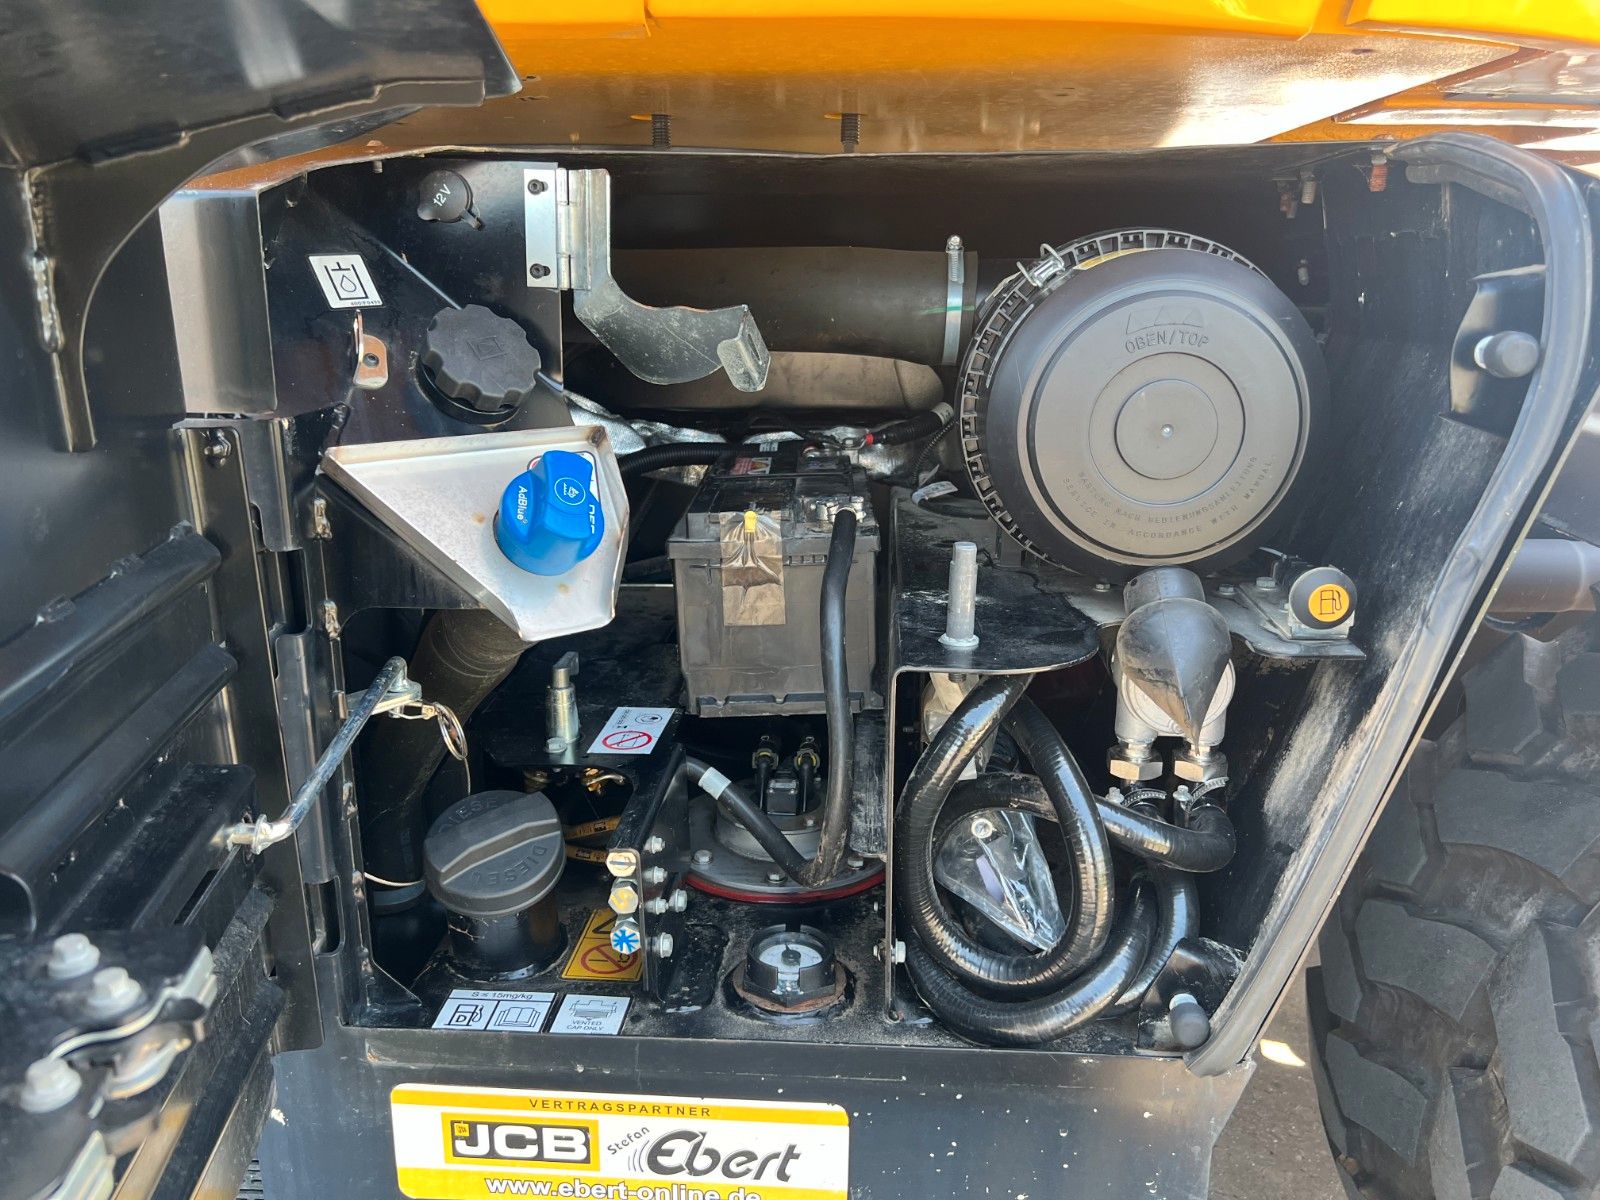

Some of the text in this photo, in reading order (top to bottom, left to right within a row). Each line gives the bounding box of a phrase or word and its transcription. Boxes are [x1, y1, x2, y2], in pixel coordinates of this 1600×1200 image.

[433, 183, 451, 207] 12V
[1125, 330, 1209, 353] OBEN/TOP
[491, 992, 533, 1000] 15mg/kg
[455, 1014, 467, 1023] D
[529, 1099, 711, 1117] VERTRAGSPARTNER
[454, 1123, 588, 1161] JCB
[607, 1127, 650, 1155] Stefan
[646, 1128, 801, 1183] Ebert
[484, 1177, 762, 1200] www.ebert-onlinede
